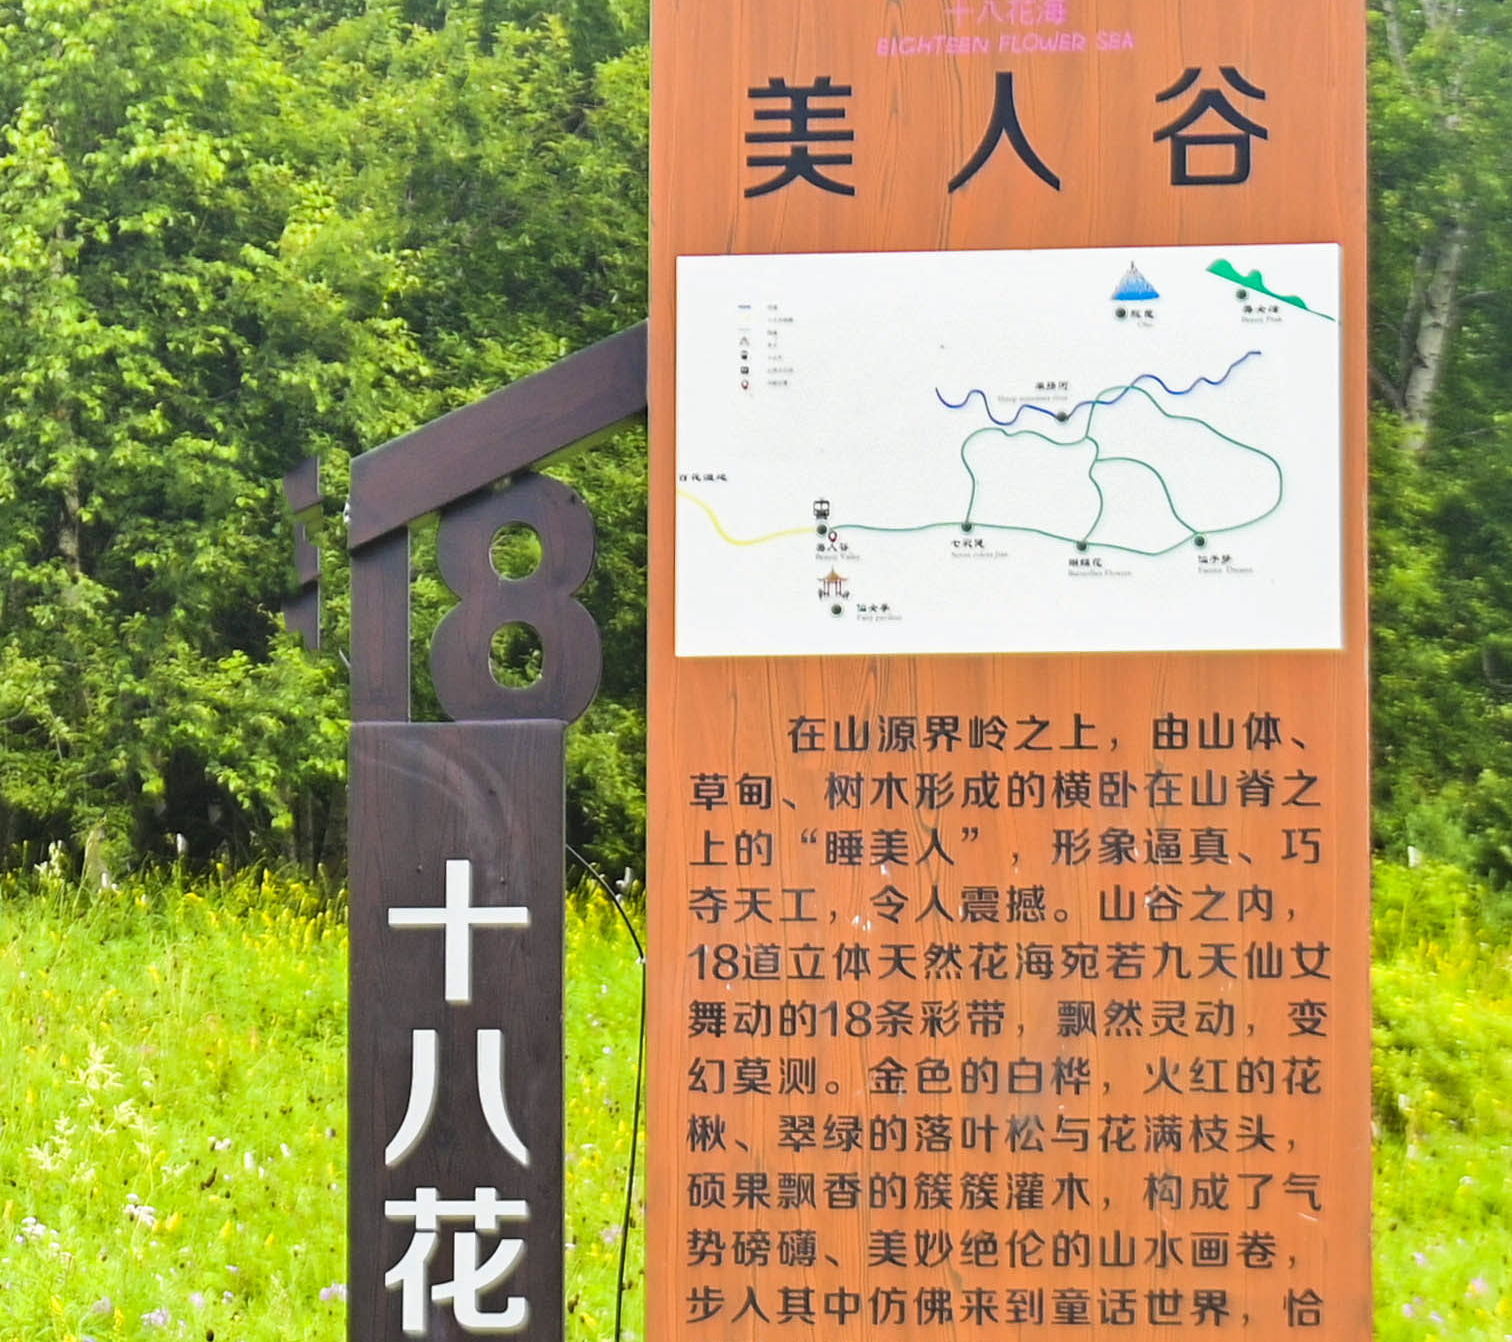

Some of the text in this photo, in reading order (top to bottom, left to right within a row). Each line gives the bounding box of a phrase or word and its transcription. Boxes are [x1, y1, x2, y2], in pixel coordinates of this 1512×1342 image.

[877, 31, 1135, 56] EIGHTEEN FLOWER SEA
[743, 66, 1269, 199] 美人谷
[350, 469, 603, 727] 18
[688, 942, 1331, 982] 18道立体天然花海宛若九天仙女
